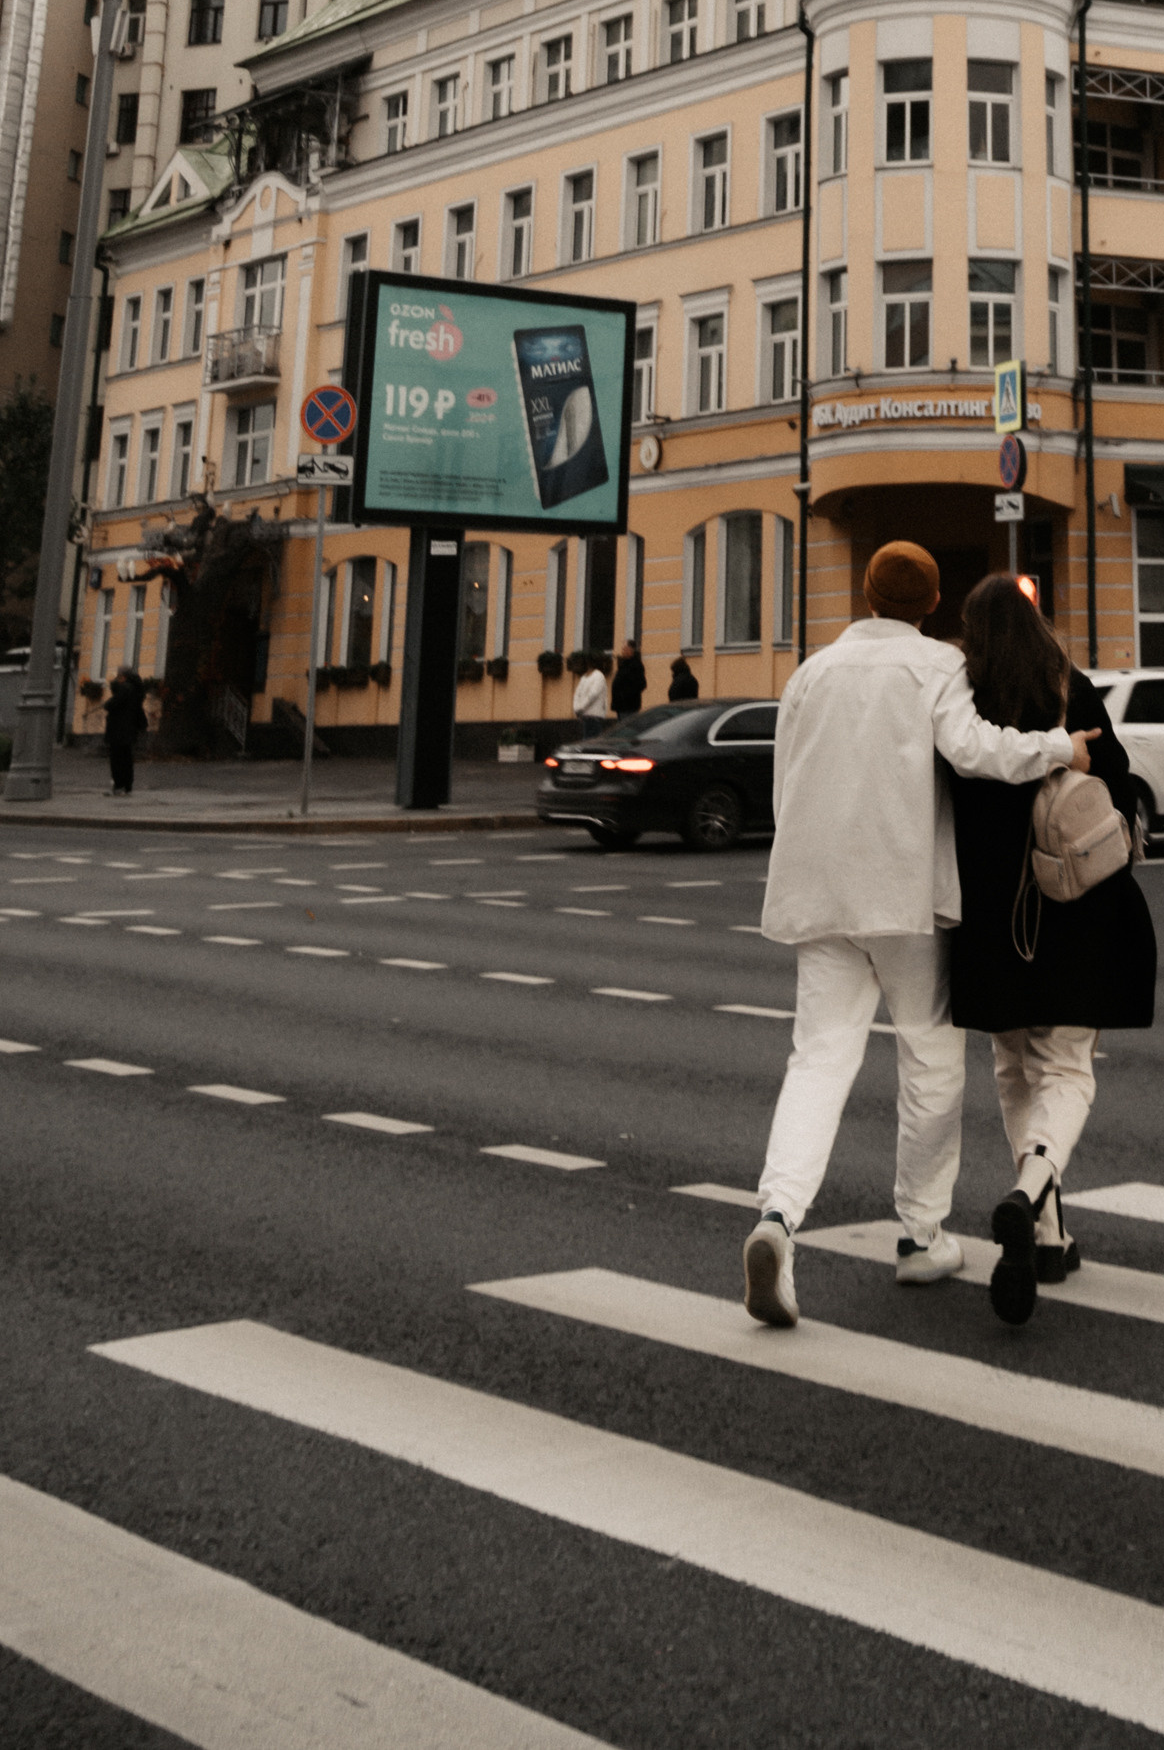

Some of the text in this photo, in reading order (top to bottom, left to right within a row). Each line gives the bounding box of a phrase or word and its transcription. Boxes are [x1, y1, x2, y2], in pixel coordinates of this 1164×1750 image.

[389, 303, 435, 319] OZON
[388, 319, 455, 352] fresh
[531, 359, 582, 379] МАТИАС
[385, 384, 429, 418] 119
[879, 396, 989, 419] Консалтинг
